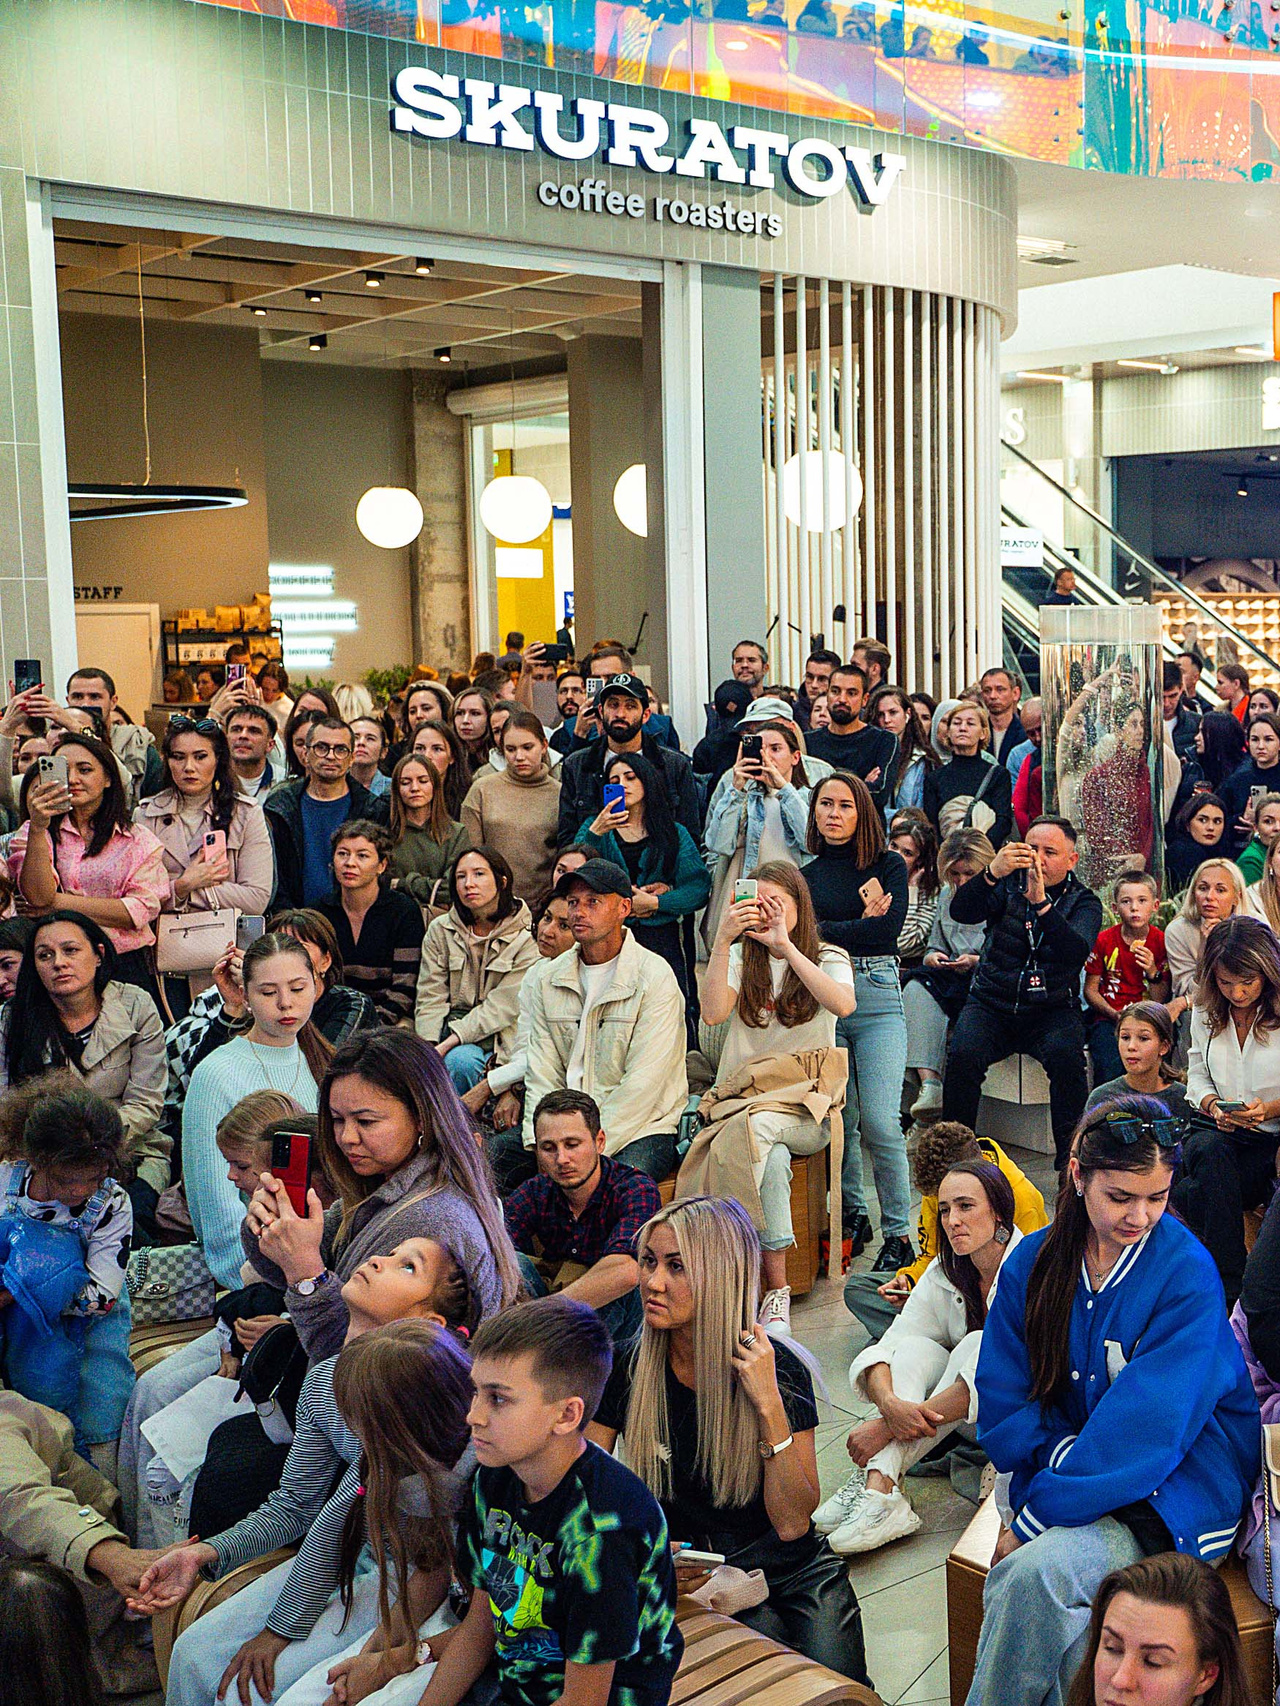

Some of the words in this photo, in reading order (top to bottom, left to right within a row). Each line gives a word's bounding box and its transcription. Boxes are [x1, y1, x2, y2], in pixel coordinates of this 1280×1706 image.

[392, 66, 907, 206] SKURATOV
[538, 178, 645, 218] coffee
[655, 198, 783, 237] roasters
[74, 586, 123, 600] STAFF
